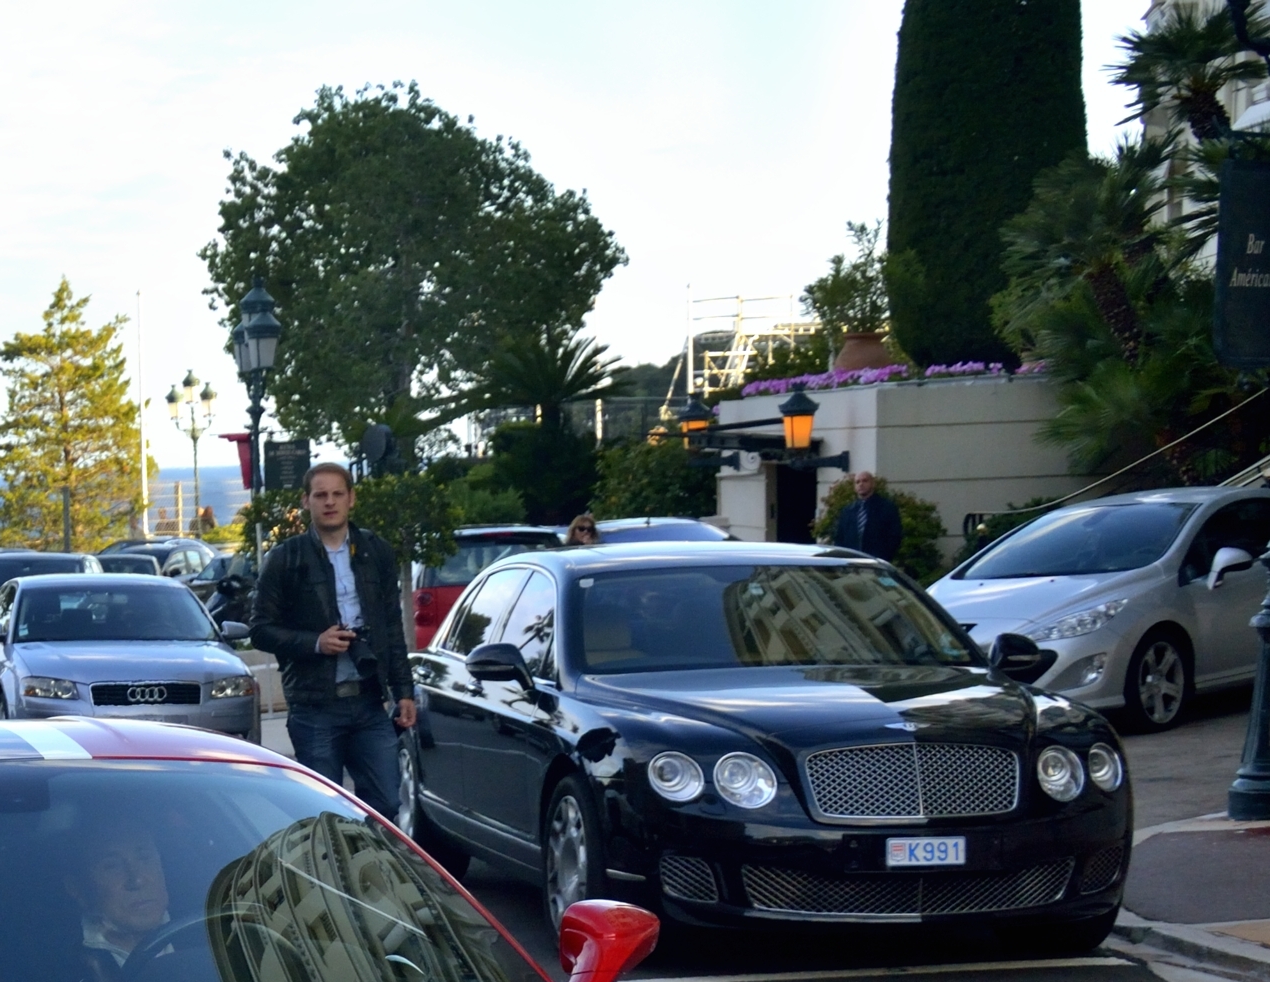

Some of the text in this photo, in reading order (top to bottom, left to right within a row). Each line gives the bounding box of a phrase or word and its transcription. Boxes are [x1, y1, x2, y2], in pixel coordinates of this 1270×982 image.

[1246, 233, 1265, 254] Bar
[1229, 266, 1270, 288] América
[908, 841, 959, 862] K991
